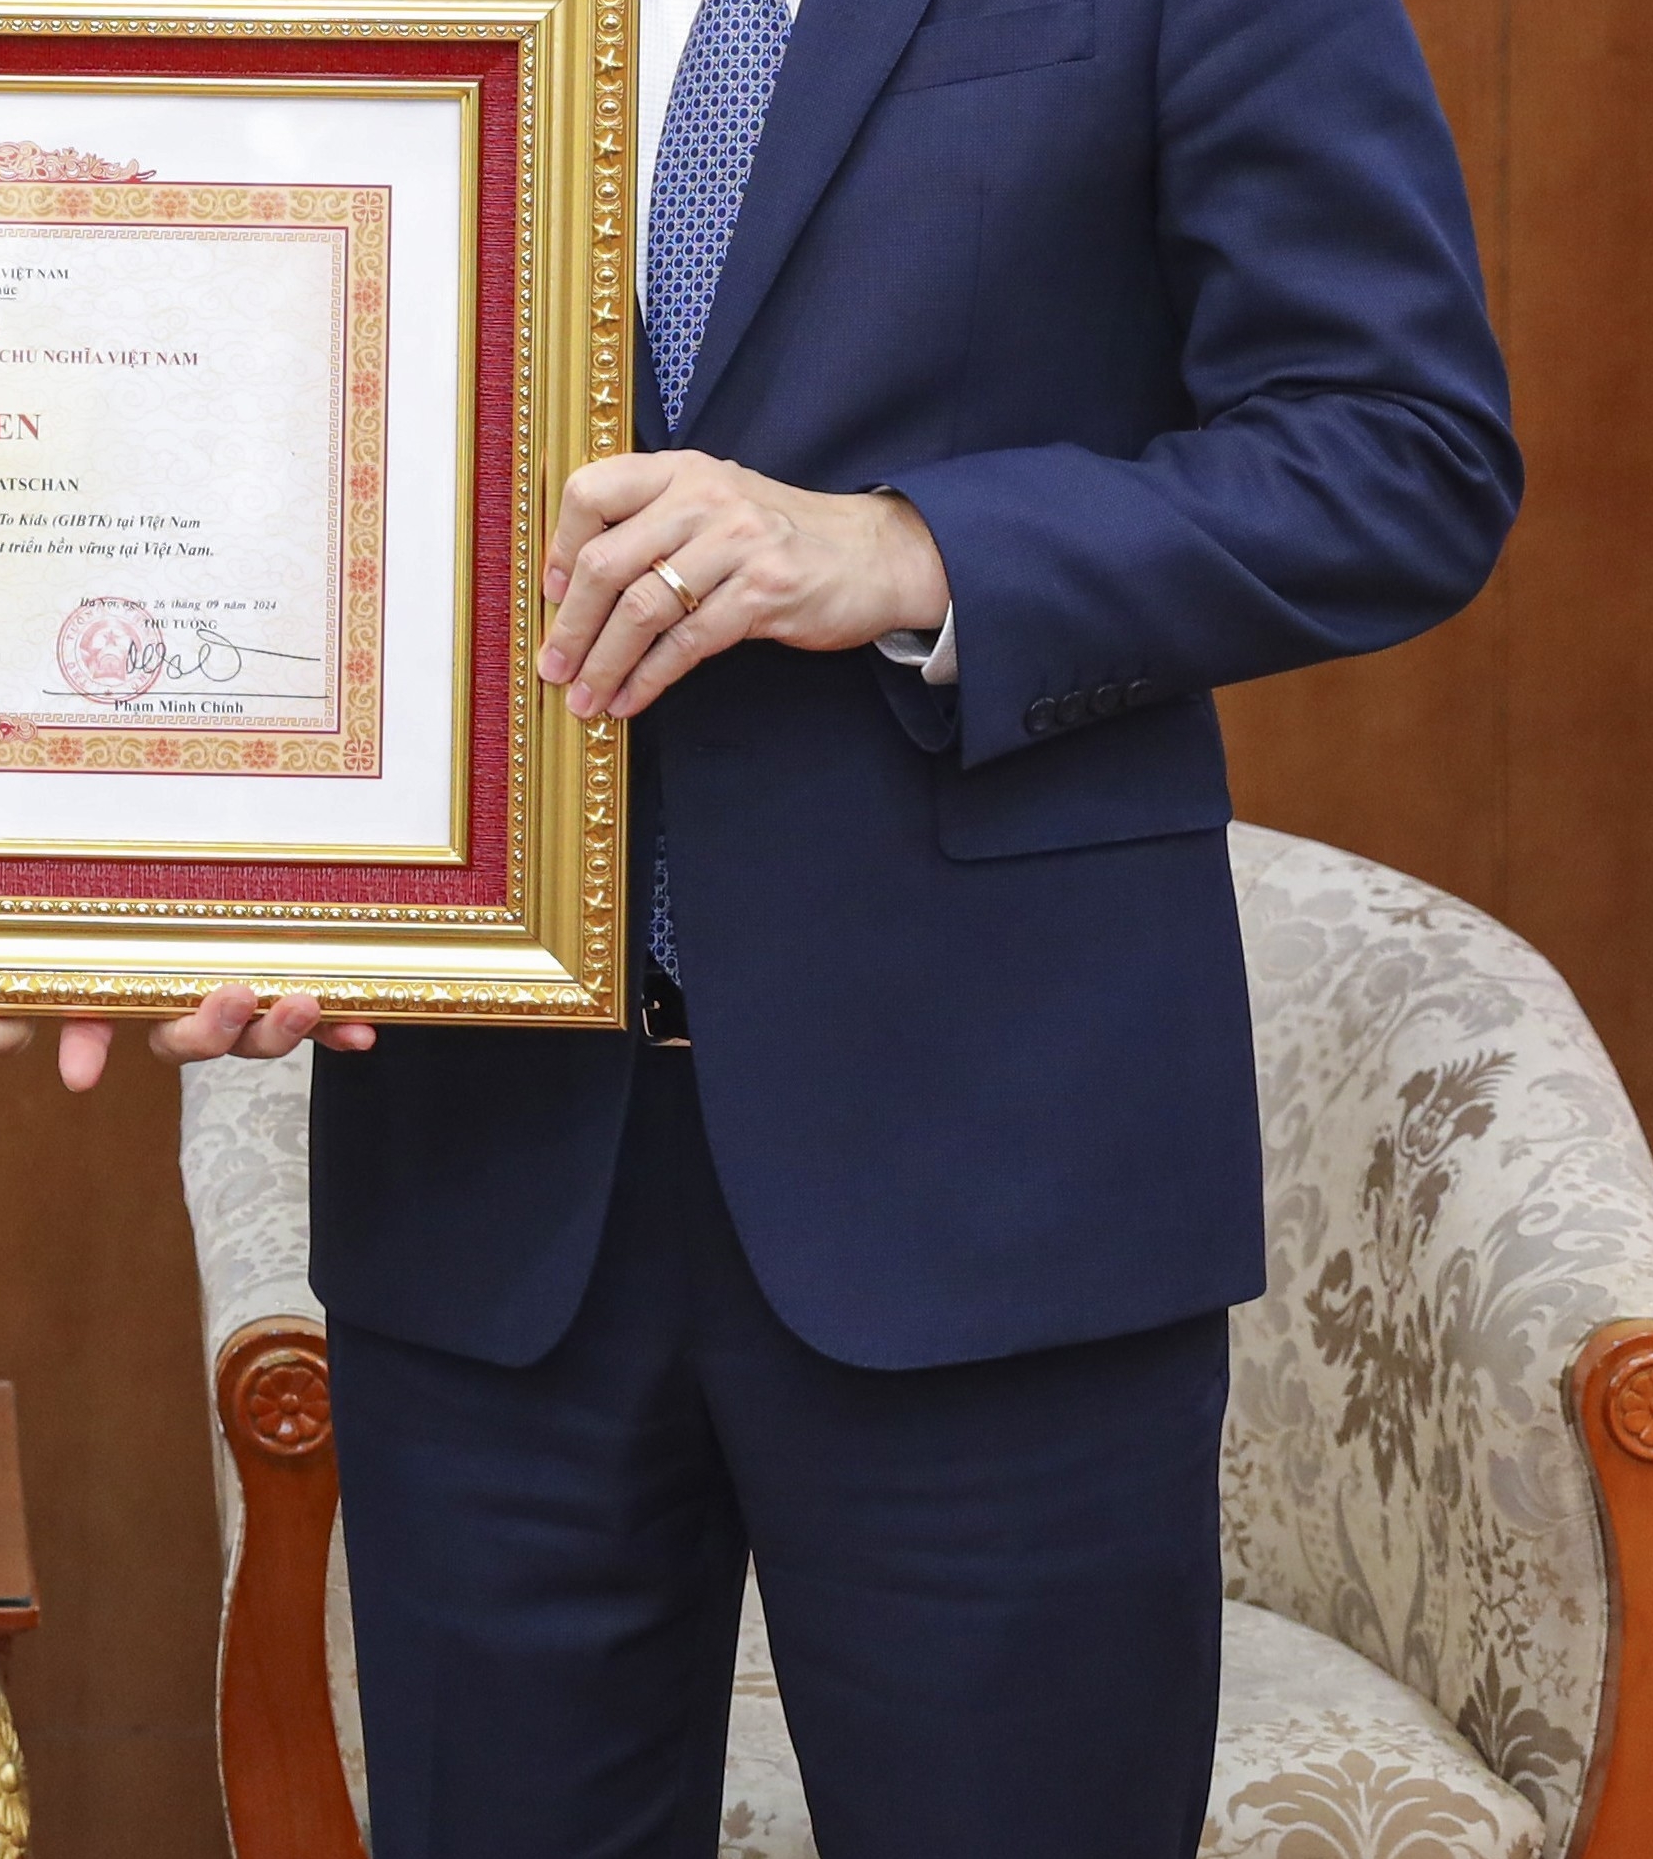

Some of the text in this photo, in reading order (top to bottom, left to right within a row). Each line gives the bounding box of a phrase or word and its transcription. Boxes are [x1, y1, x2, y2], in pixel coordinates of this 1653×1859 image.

[2, 267, 34, 280] VIỆT
[38, 269, 70, 279] NAM
[44, 347, 104, 364] NGHĨA
[107, 349, 151, 369] VIỆT
[156, 352, 199, 366] NAM
[0, 513, 14, 526] To
[18, 513, 48, 527] Kids
[52, 514, 113, 529] (GIBTK)
[117, 516, 135, 531] tại
[170, 516, 201, 529] Nam
[9, 537, 43, 554] triển
[47, 537, 73, 554] bền
[79, 542, 115, 558] vững
[119, 543, 138, 558] tại
[176, 543, 215, 557] Nam.
[153, 599, 165, 610] 26
[171, 599, 200, 611] tháng
[206, 600, 219, 610] 09
[224, 599, 246, 610] năm
[253, 600, 277, 610] 2024
[114, 700, 244, 715] Phạm Minh Chính
